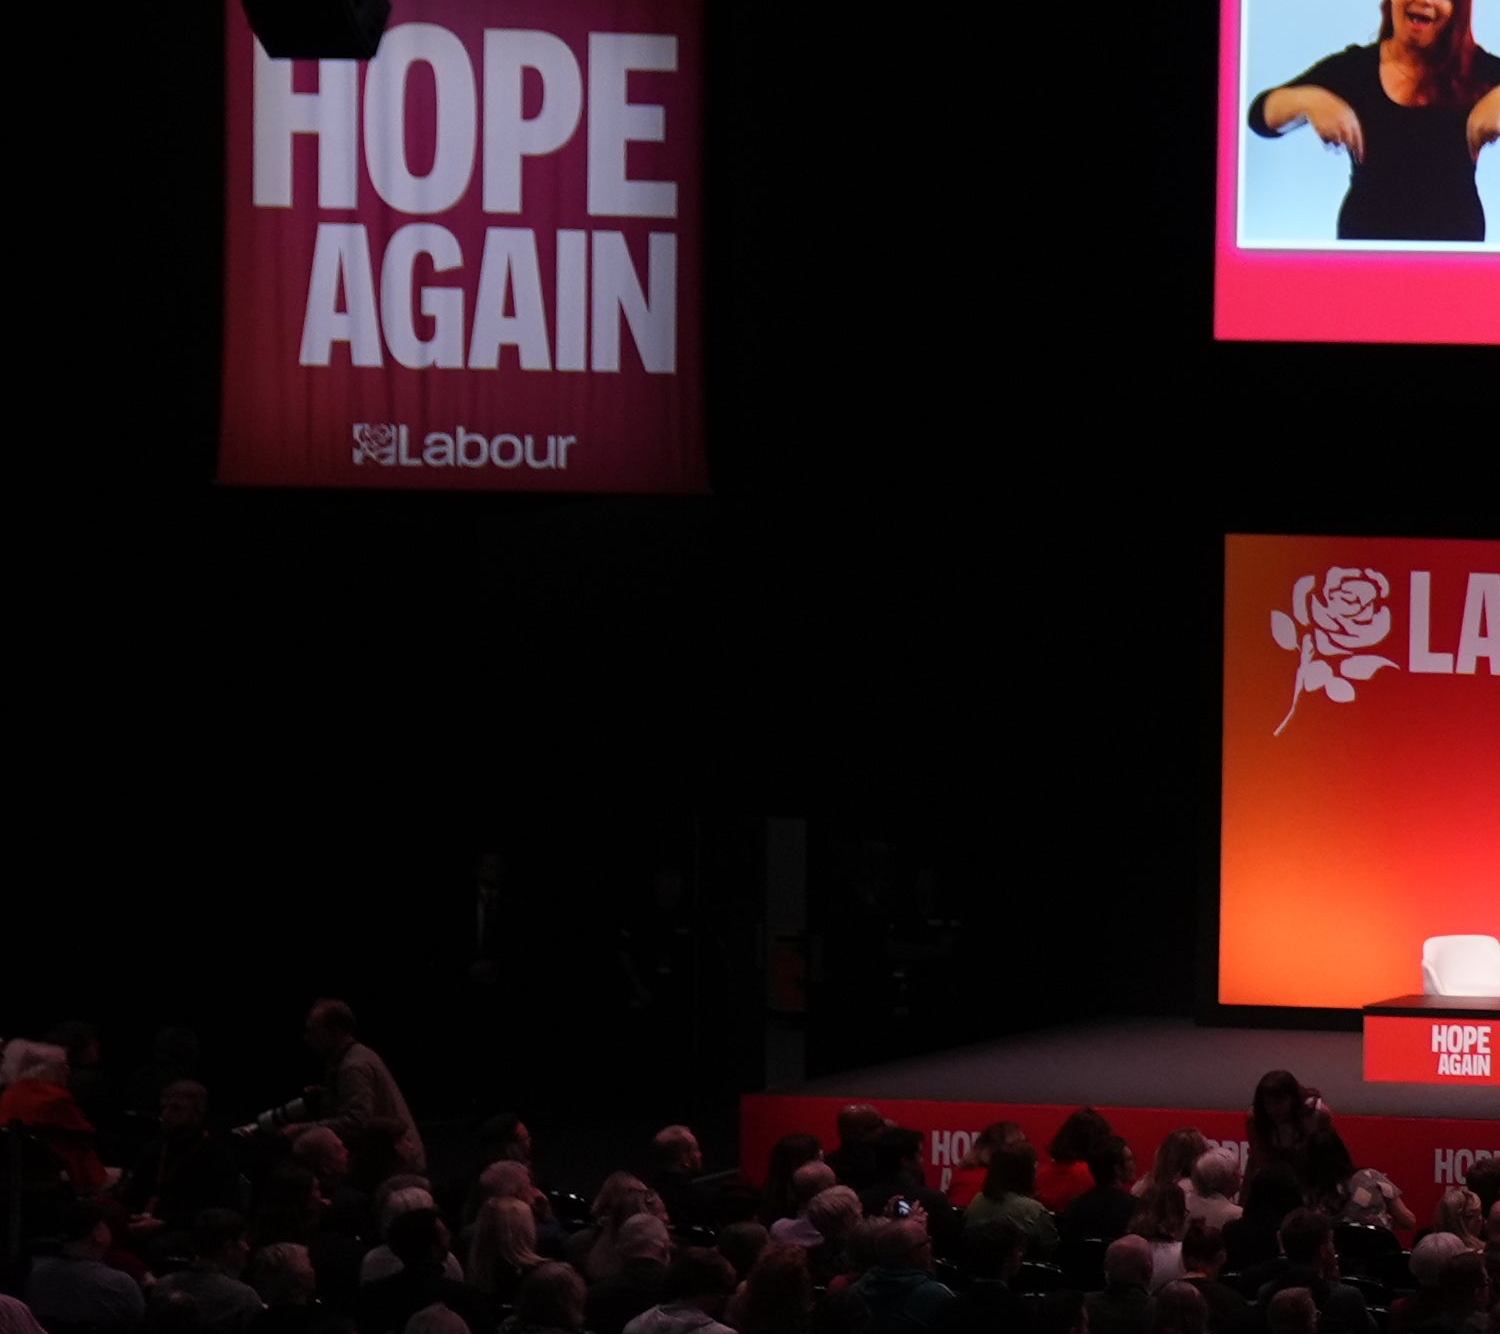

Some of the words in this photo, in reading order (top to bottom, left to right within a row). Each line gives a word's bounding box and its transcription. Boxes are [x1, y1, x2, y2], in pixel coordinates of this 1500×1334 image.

[252, 22, 679, 220] HOPE
[298, 222, 678, 375] AGAIN
[399, 424, 577, 469] Labour
[1431, 1024, 1492, 1054] HOPE
[1437, 1053, 1492, 1077] AGAIN
